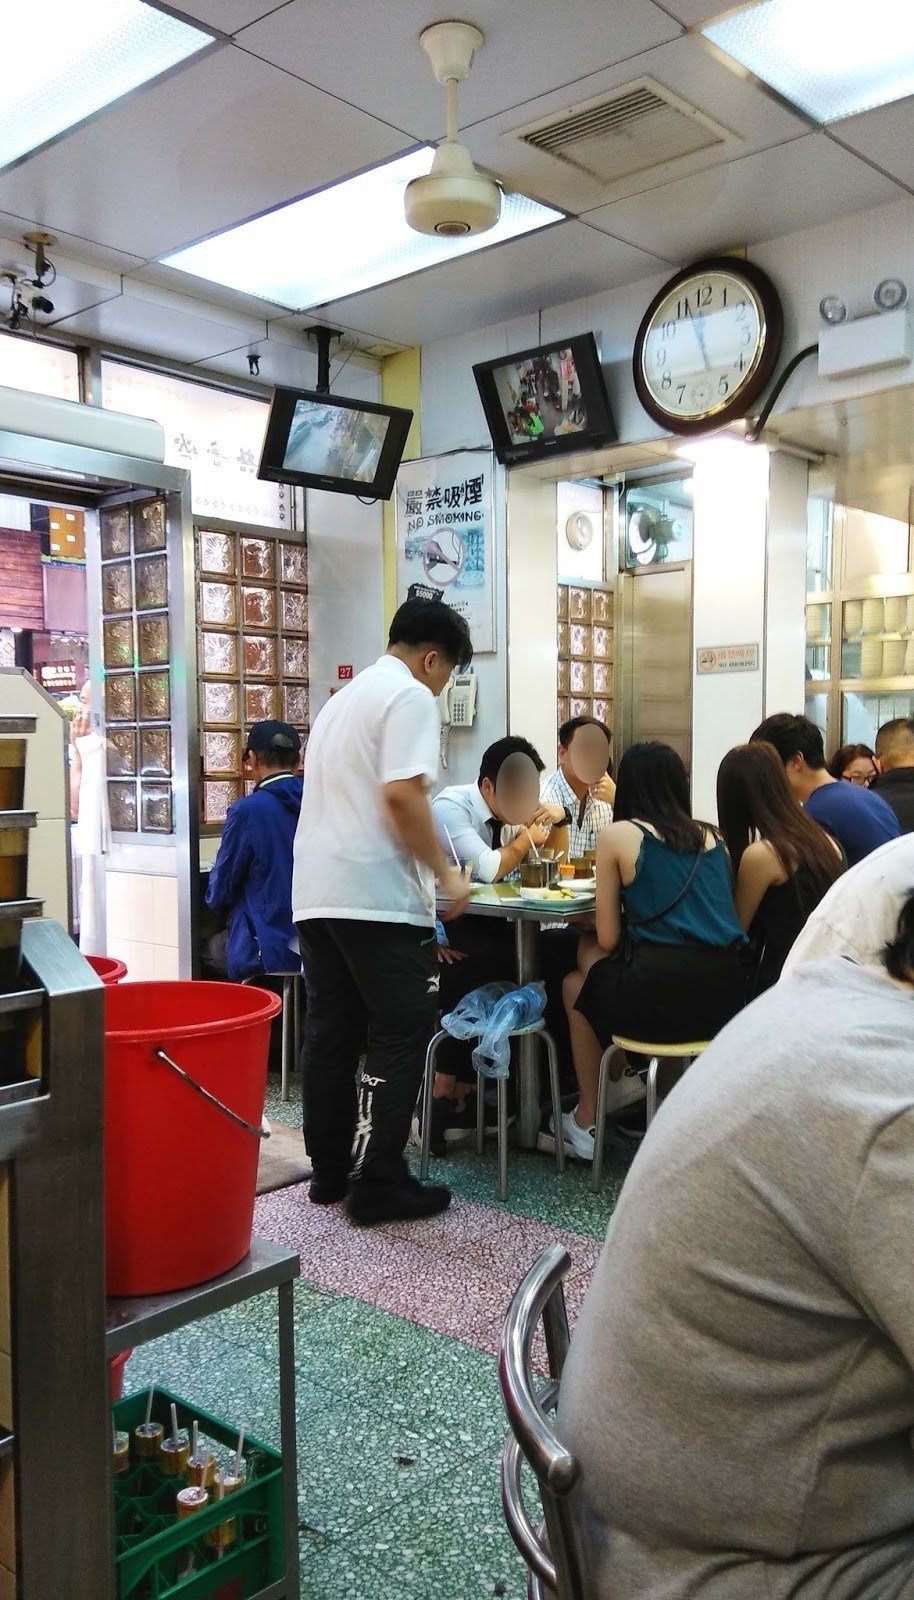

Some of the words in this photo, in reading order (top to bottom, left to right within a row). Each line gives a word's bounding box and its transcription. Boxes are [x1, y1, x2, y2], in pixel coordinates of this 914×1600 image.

[697, 286, 712, 308] 12
[722, 287, 727, 308] 1
[676, 298, 688, 320] 11
[735, 301, 746, 320] 2
[662, 320, 676, 340] 10
[656, 349, 666, 366] 9
[734, 353, 746, 372] 4
[661, 371, 672, 391] 8
[718, 375, 729, 395] 5
[676, 385, 686, 405] 7
[406, 474, 484, 516] 嚴禁吸煙
[408, 517, 424, 532] NO
[427, 511, 481, 527] SMOKING
[415, 590, 433, 600] $5000
[340, 667, 351, 677] 27
